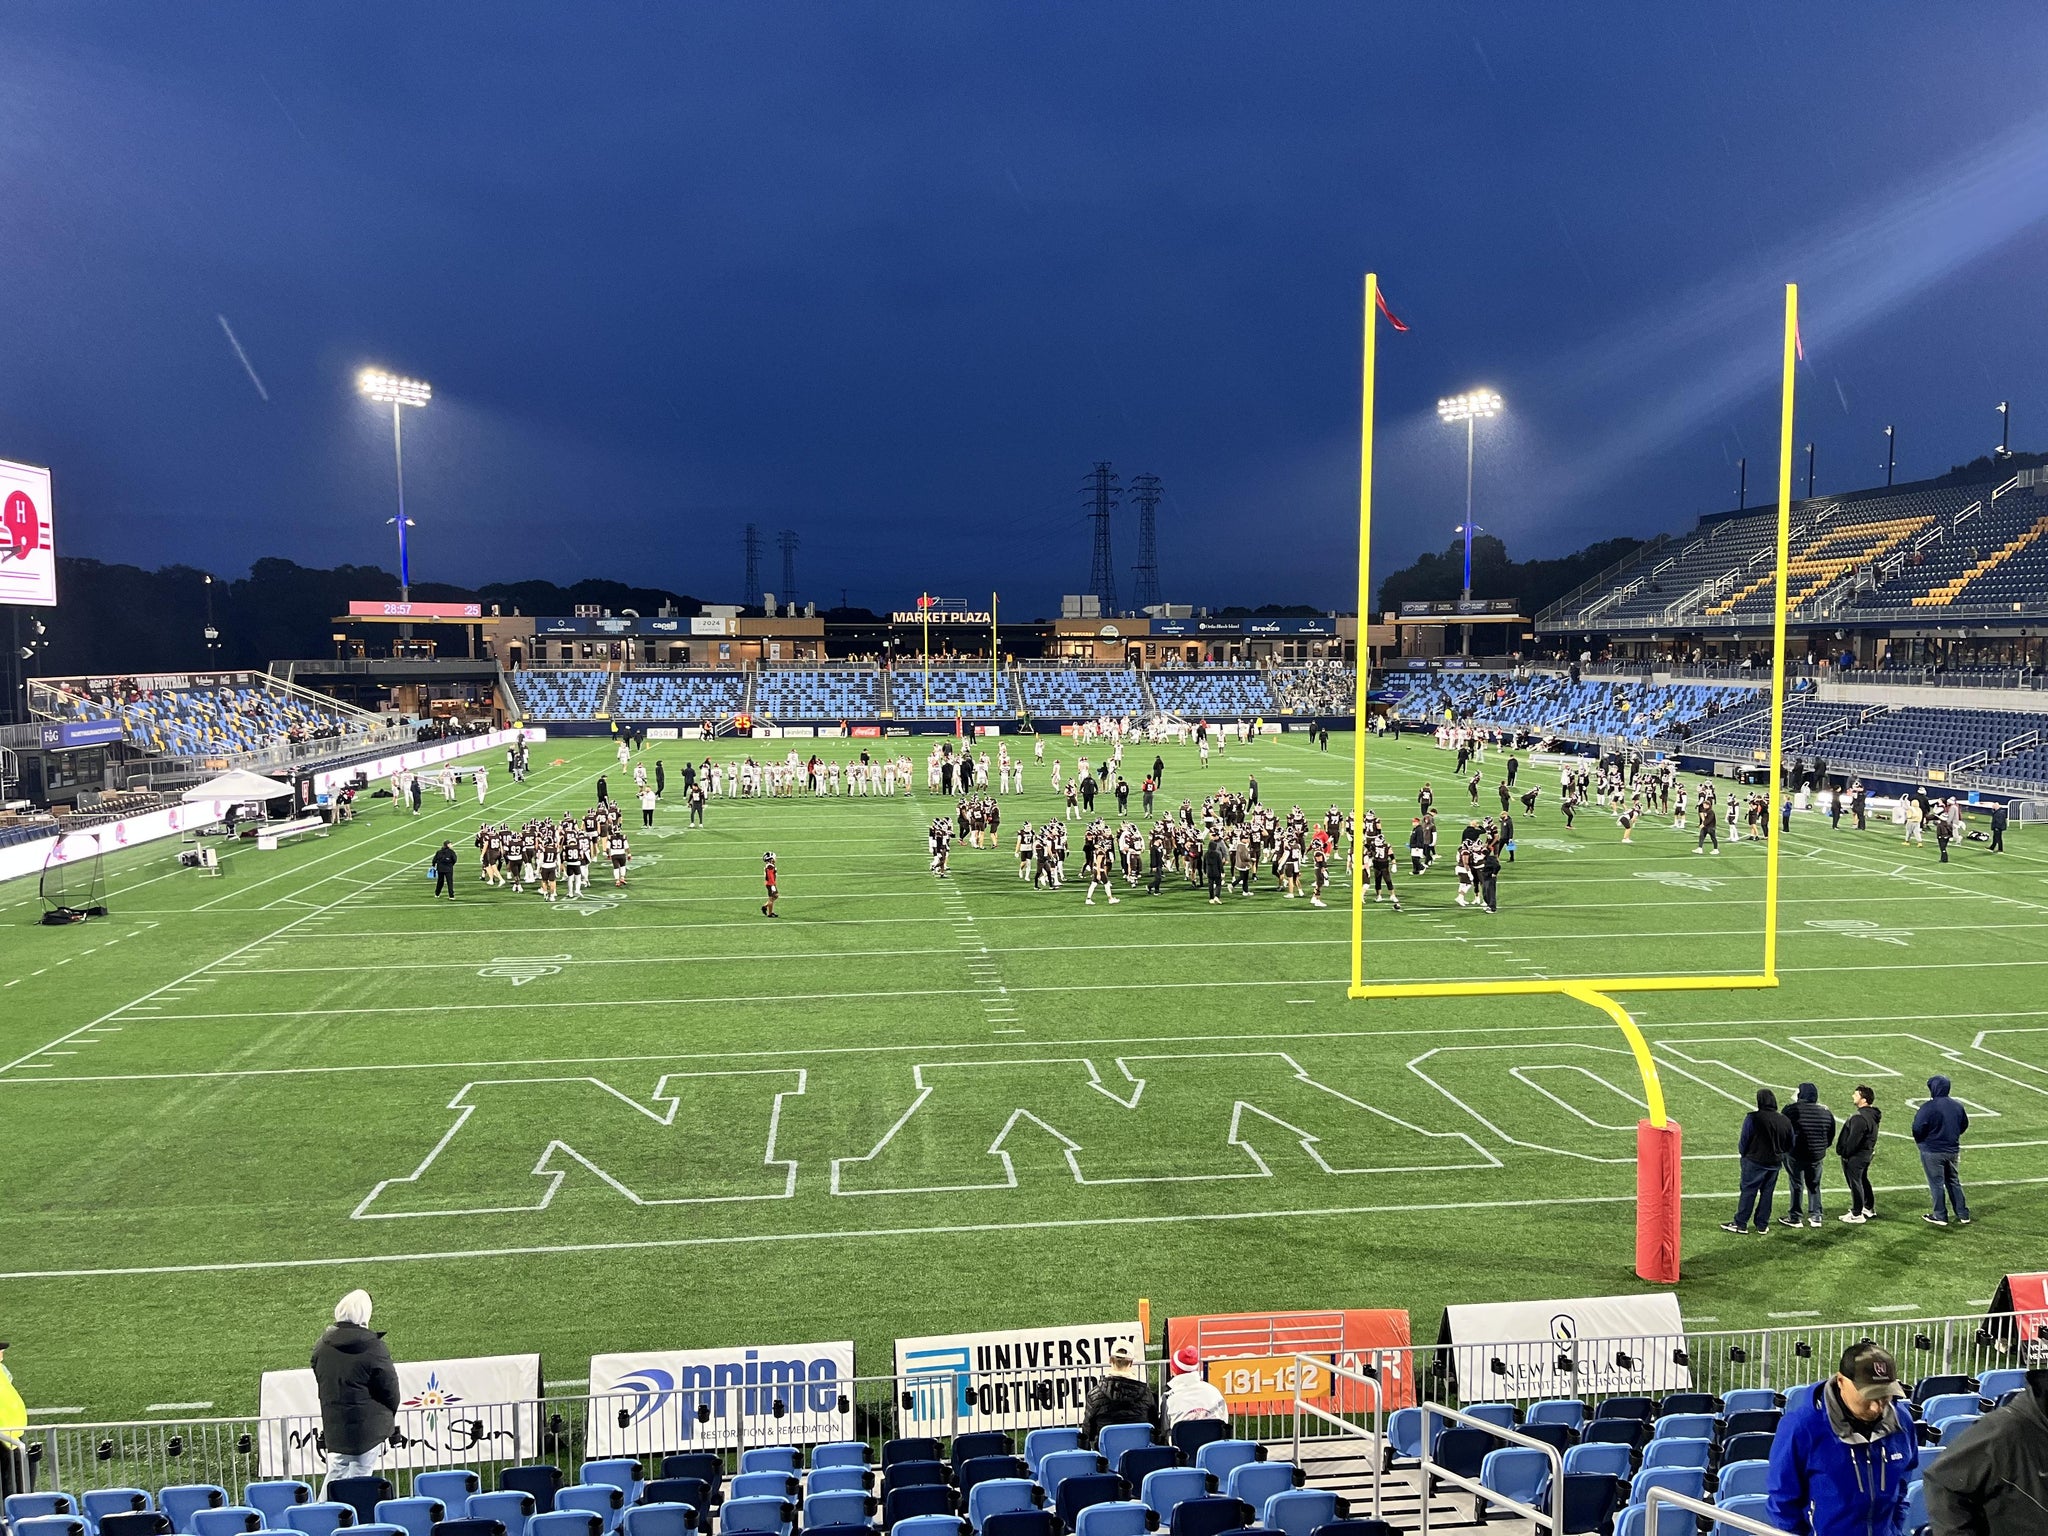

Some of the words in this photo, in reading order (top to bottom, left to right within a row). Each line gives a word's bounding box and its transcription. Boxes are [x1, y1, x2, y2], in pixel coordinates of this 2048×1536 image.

[15, 500, 27, 524] H
[384, 604, 412, 615] 28:57
[893, 611, 948, 623] MARKET
[950, 611, 991, 623] PLAZA
[154, 675, 190, 689] FOOTBALL
[735, 716, 751, 728] 25
[649, 730, 677, 738] SASAKI
[764, 729, 771, 737] B
[351, 1026, 2048, 1221] ROWN
[1502, 1362, 1545, 1380] NEW
[1553, 1357, 1645, 1377] EGLAD
[1223, 1364, 1319, 1395] 131-132
[681, 1350, 838, 1441] prime
[701, 1427, 765, 1441] RESTORTION
[767, 1426, 775, 1436] &
[777, 1424, 840, 1436] REMEDIATION
